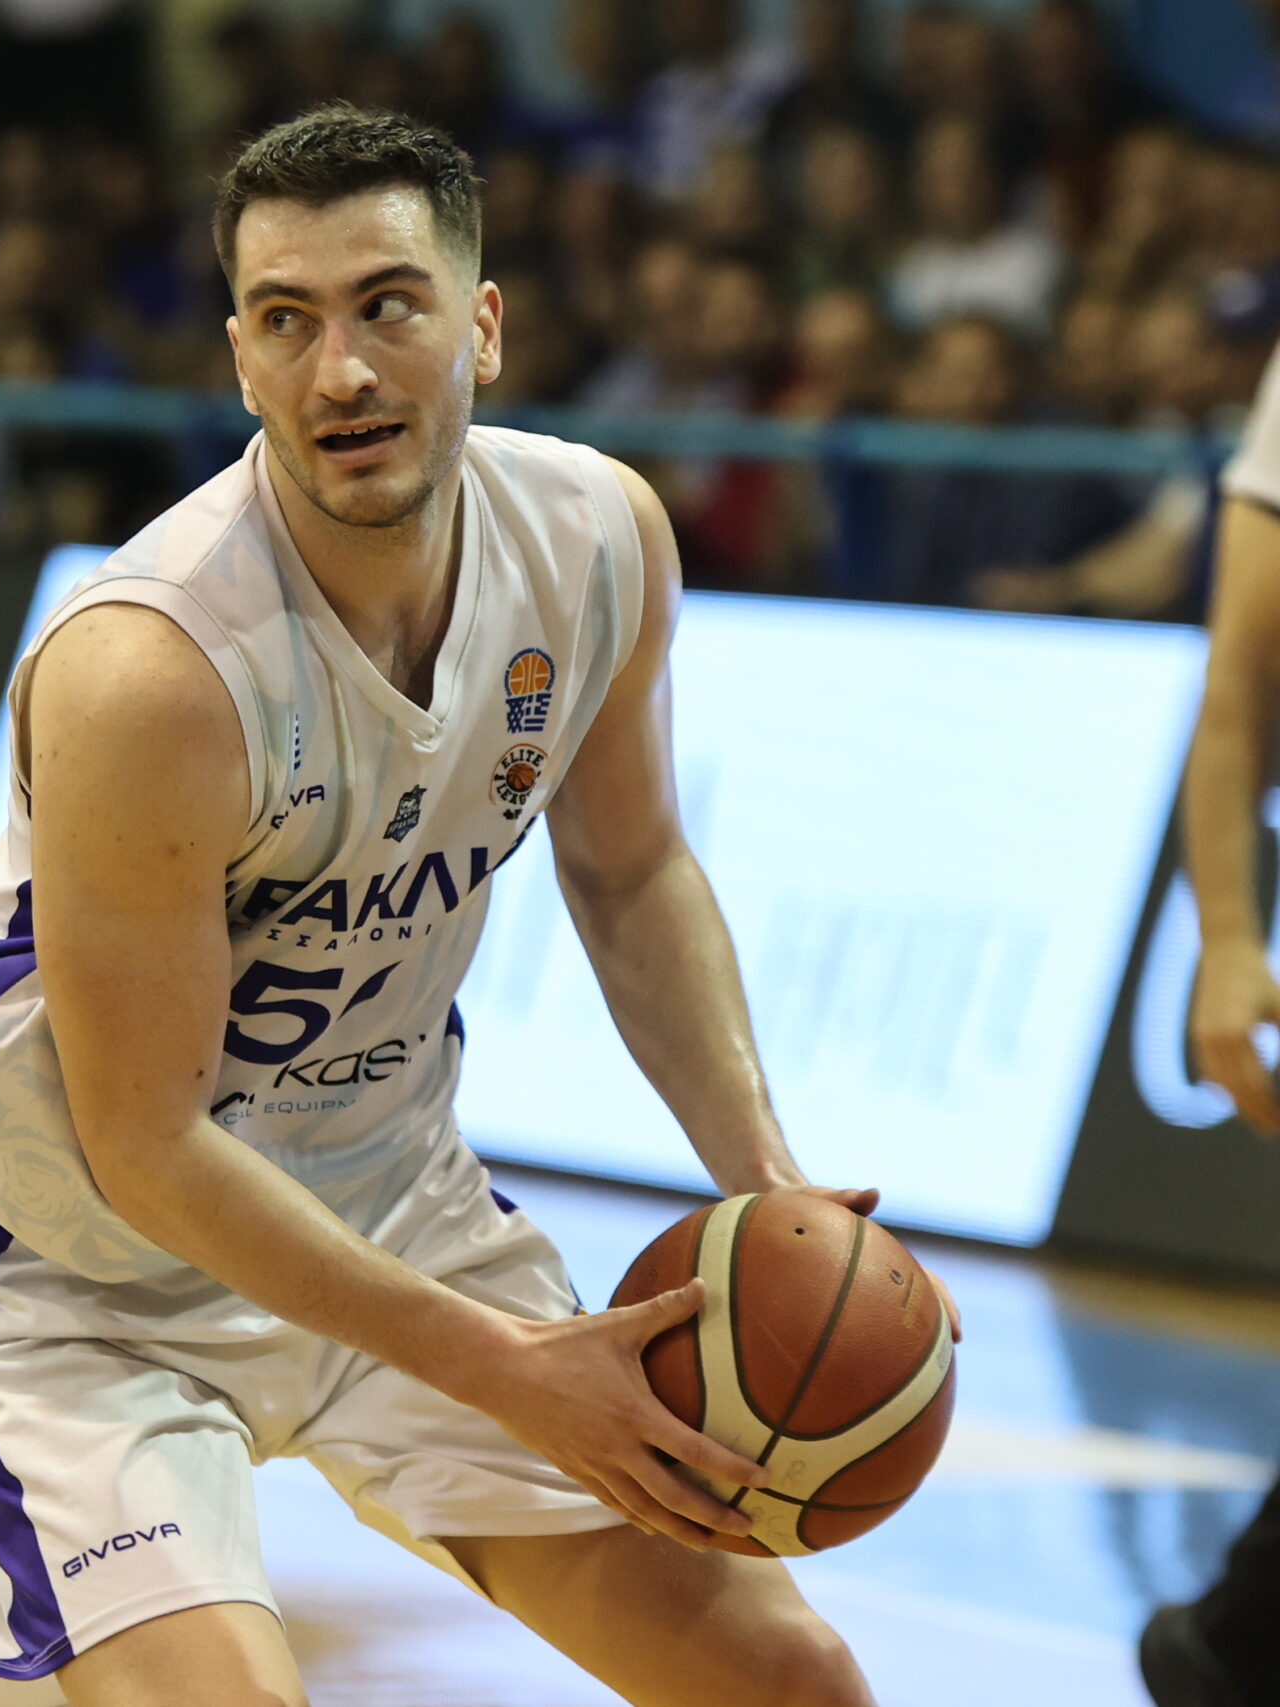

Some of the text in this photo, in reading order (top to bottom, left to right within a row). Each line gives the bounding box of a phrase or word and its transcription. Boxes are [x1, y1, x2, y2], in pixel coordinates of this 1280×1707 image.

[500, 748, 545, 771] ELITE
[496, 784, 533, 806] LEAG
[62, 1523, 182, 1578] GIVOVA
